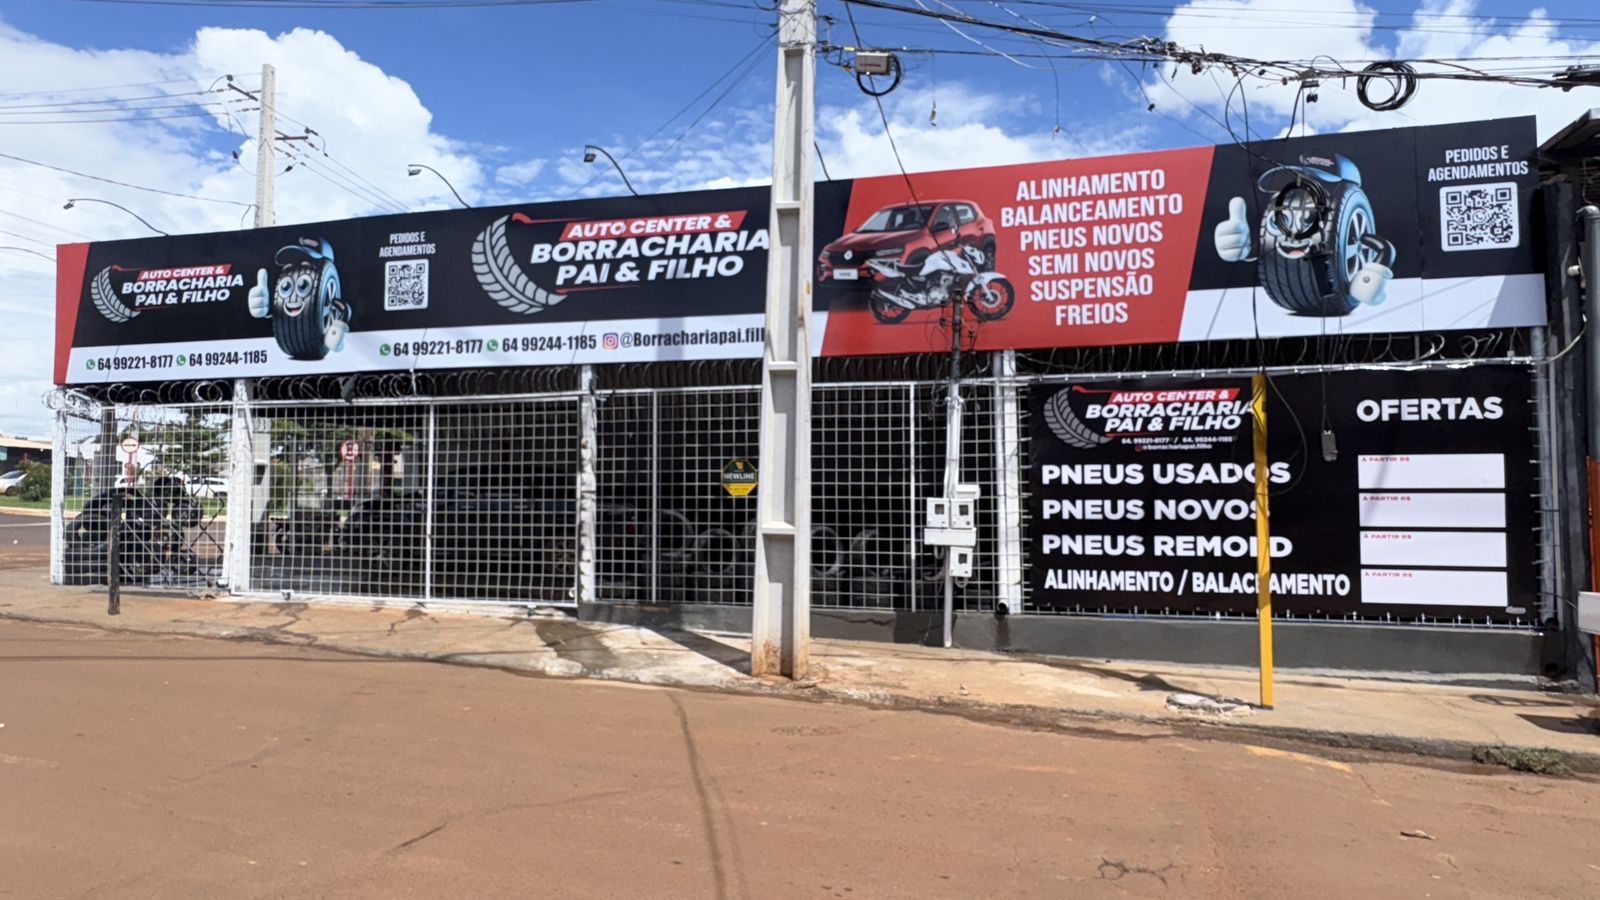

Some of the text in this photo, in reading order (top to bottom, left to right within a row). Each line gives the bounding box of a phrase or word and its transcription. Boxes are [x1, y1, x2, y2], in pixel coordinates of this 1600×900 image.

[1445, 145, 1510, 163] PEDIDOS E
[1427, 161, 1529, 182] AGENDAMENTOS
[1016, 169, 1166, 201] ALINHAMENTO
[1000, 193, 1184, 228] BALANCEAMENTO
[567, 214, 732, 239] AUTO CENTER &
[1020, 221, 1164, 251] PNEUS NOVOS
[389, 232, 427, 245] PEDIDOS E
[530, 228, 769, 265] BORRACHARIA
[379, 243, 436, 257] AGENDAMENTOS
[141, 266, 225, 280] AUTO CENTER &
[555, 255, 744, 287] PAI & FILHO
[1028, 248, 1156, 276] SEMI NOVOS
[122, 273, 244, 294] BORRACHARIA
[1030, 272, 1154, 301] SUSPENSÃO
[135, 288, 231, 307] PAI & FILHO
[1055, 302, 1129, 326] FREIOS
[393, 345, 410, 356] 64
[412, 338, 483, 356] 99221-8177
[502, 341, 519, 352] 64
[521, 334, 598, 352] 99244-1185
[97, 349, 268, 371] 64 99221-8177 64 99244-1185
[1112, 389, 1229, 403] AUTO CENTER &
[1356, 396, 1504, 422] OFERTAS
[1105, 415, 1242, 432] PAI & FILHO
[1041, 462, 1292, 485] PNEUS USADOS
[1041, 499, 1145, 520] PNEUS
[1041, 535, 1145, 556] PNEUS
[1044, 569, 1174, 592] ALINHAMENTO
[1177, 569, 1188, 596] /
